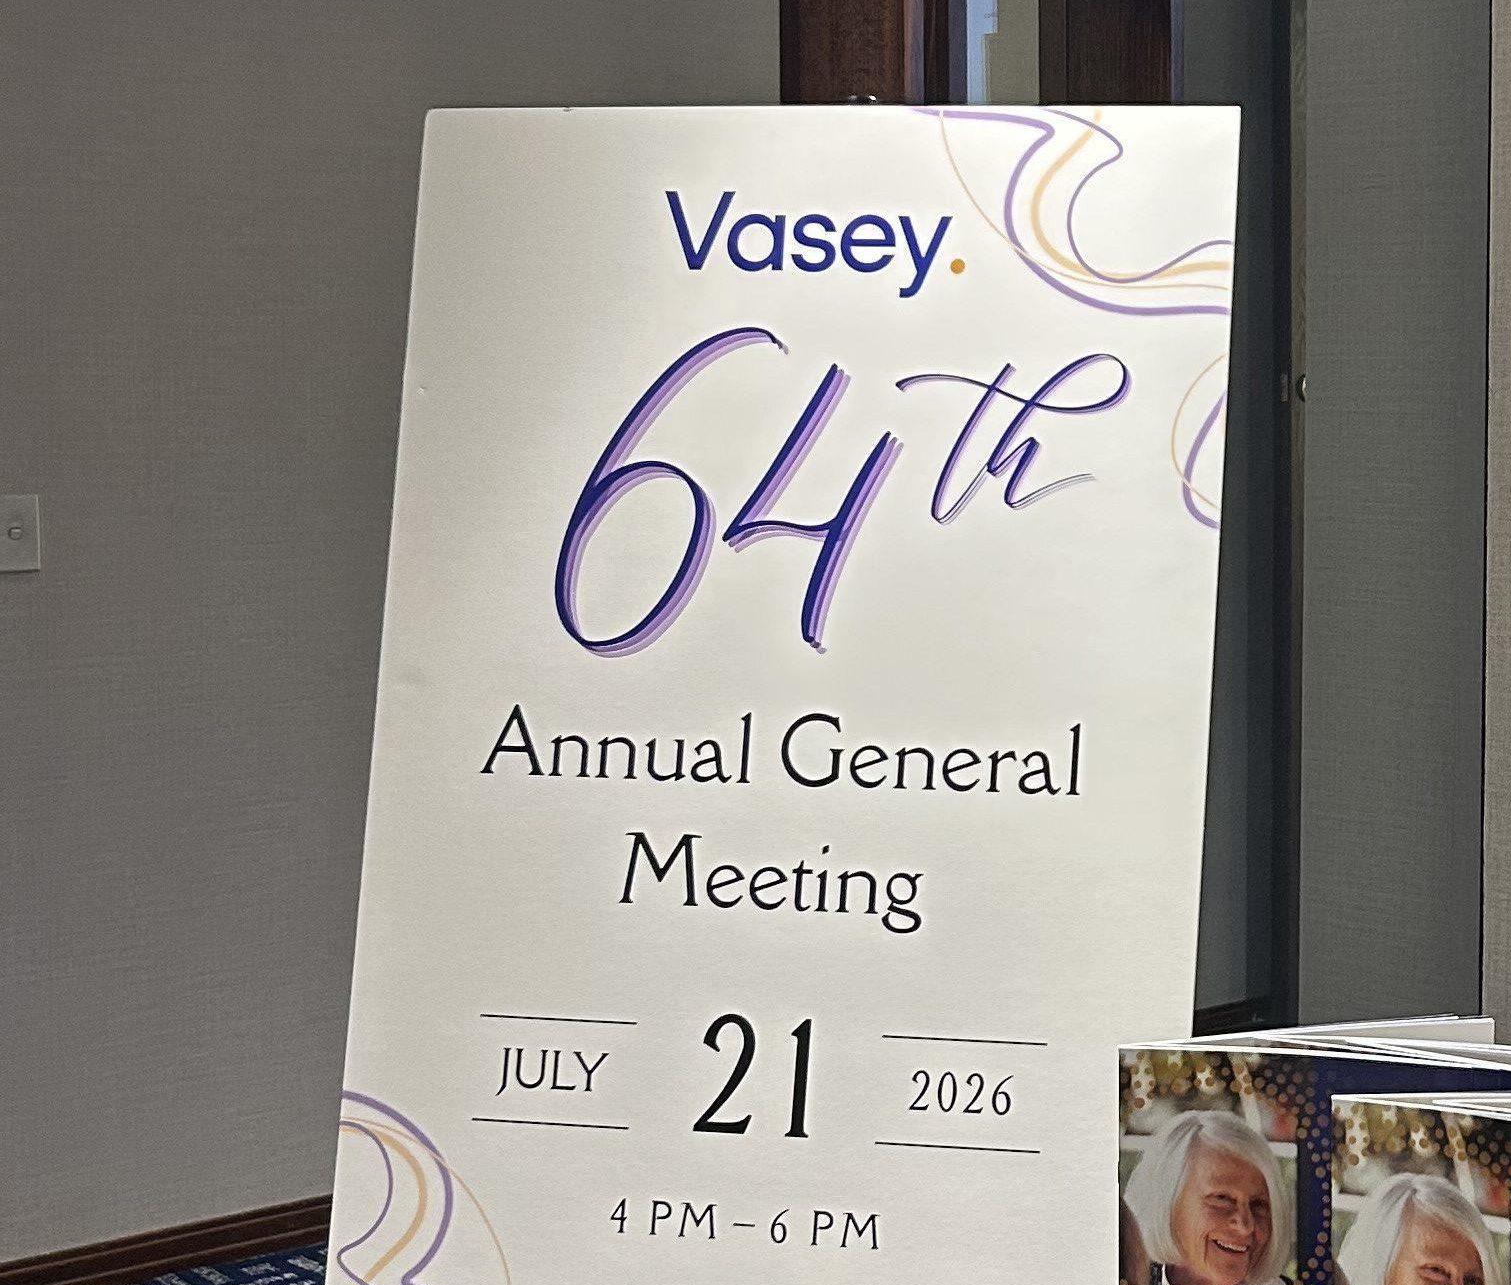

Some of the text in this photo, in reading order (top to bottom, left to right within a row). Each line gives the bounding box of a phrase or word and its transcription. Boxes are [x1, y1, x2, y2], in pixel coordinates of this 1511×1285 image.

[479, 703, 1082, 796] Annual General
[618, 832, 923, 933] Meeting
[495, 1013, 1014, 1138] JULY 21 2026
[610, 1198, 628, 1234] 4
[649, 1200, 717, 1240] PM
[770, 1208, 789, 1244] 6
[810, 1210, 880, 1251] PM
